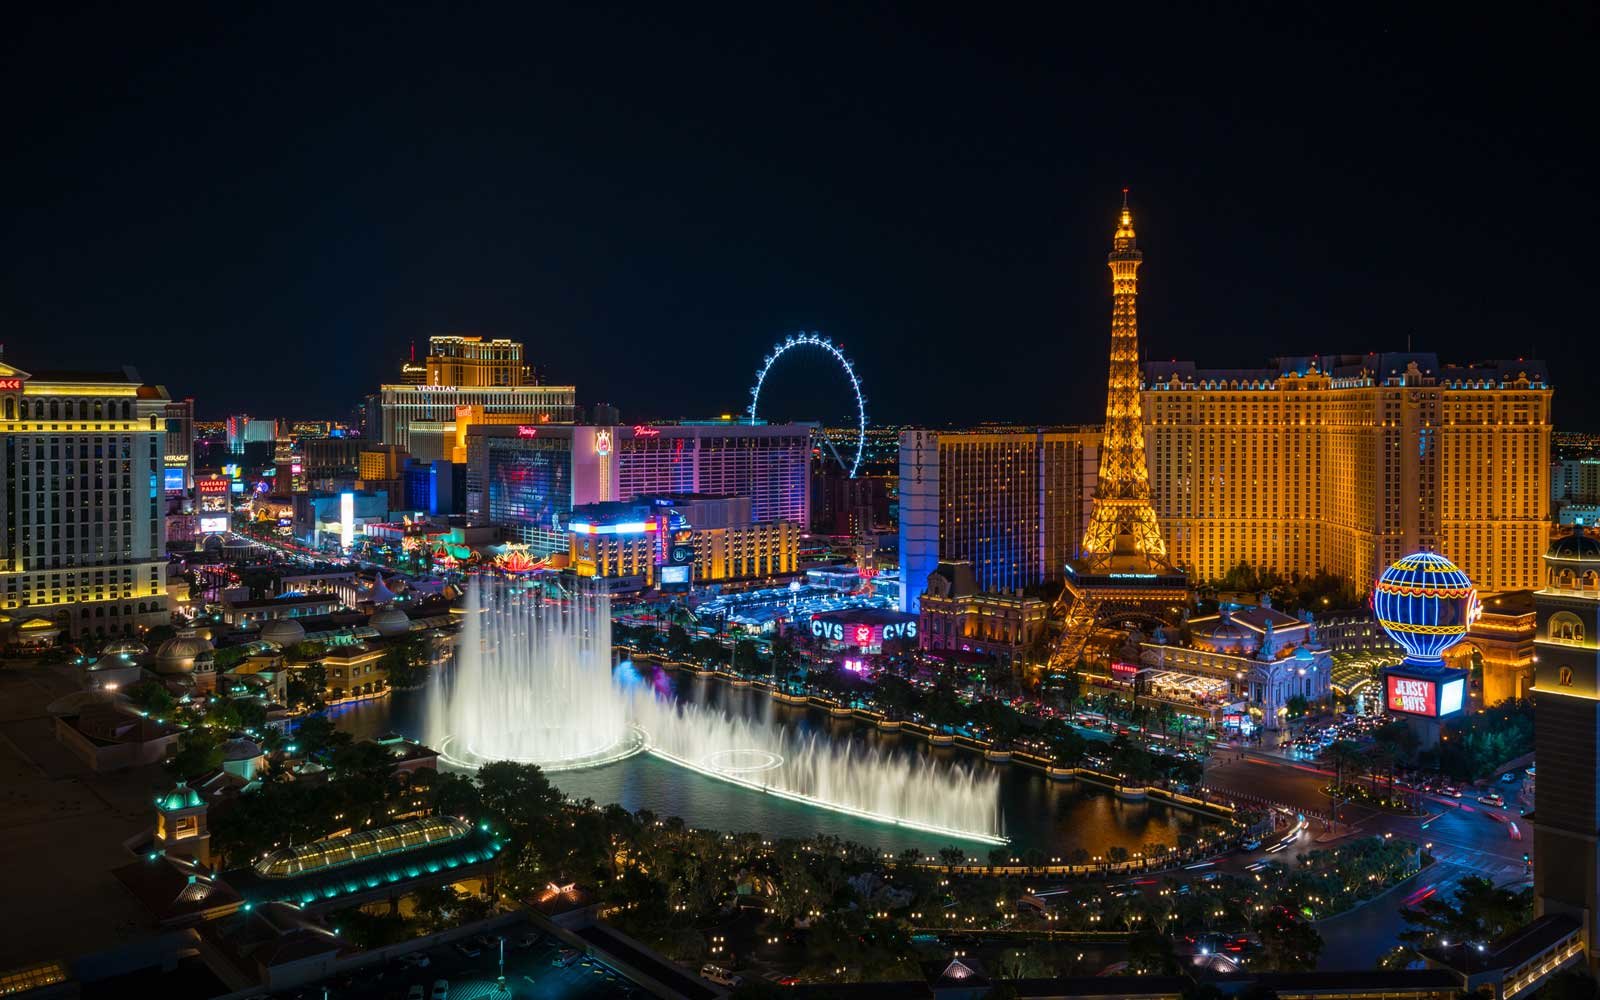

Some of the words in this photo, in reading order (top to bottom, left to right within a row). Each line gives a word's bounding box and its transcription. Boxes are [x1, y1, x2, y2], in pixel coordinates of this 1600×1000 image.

[812, 620, 843, 640] CVS
[882, 621, 916, 640] CVS
[1395, 680, 1428, 697] JERSEY
[1402, 694, 1426, 712] BOYS
